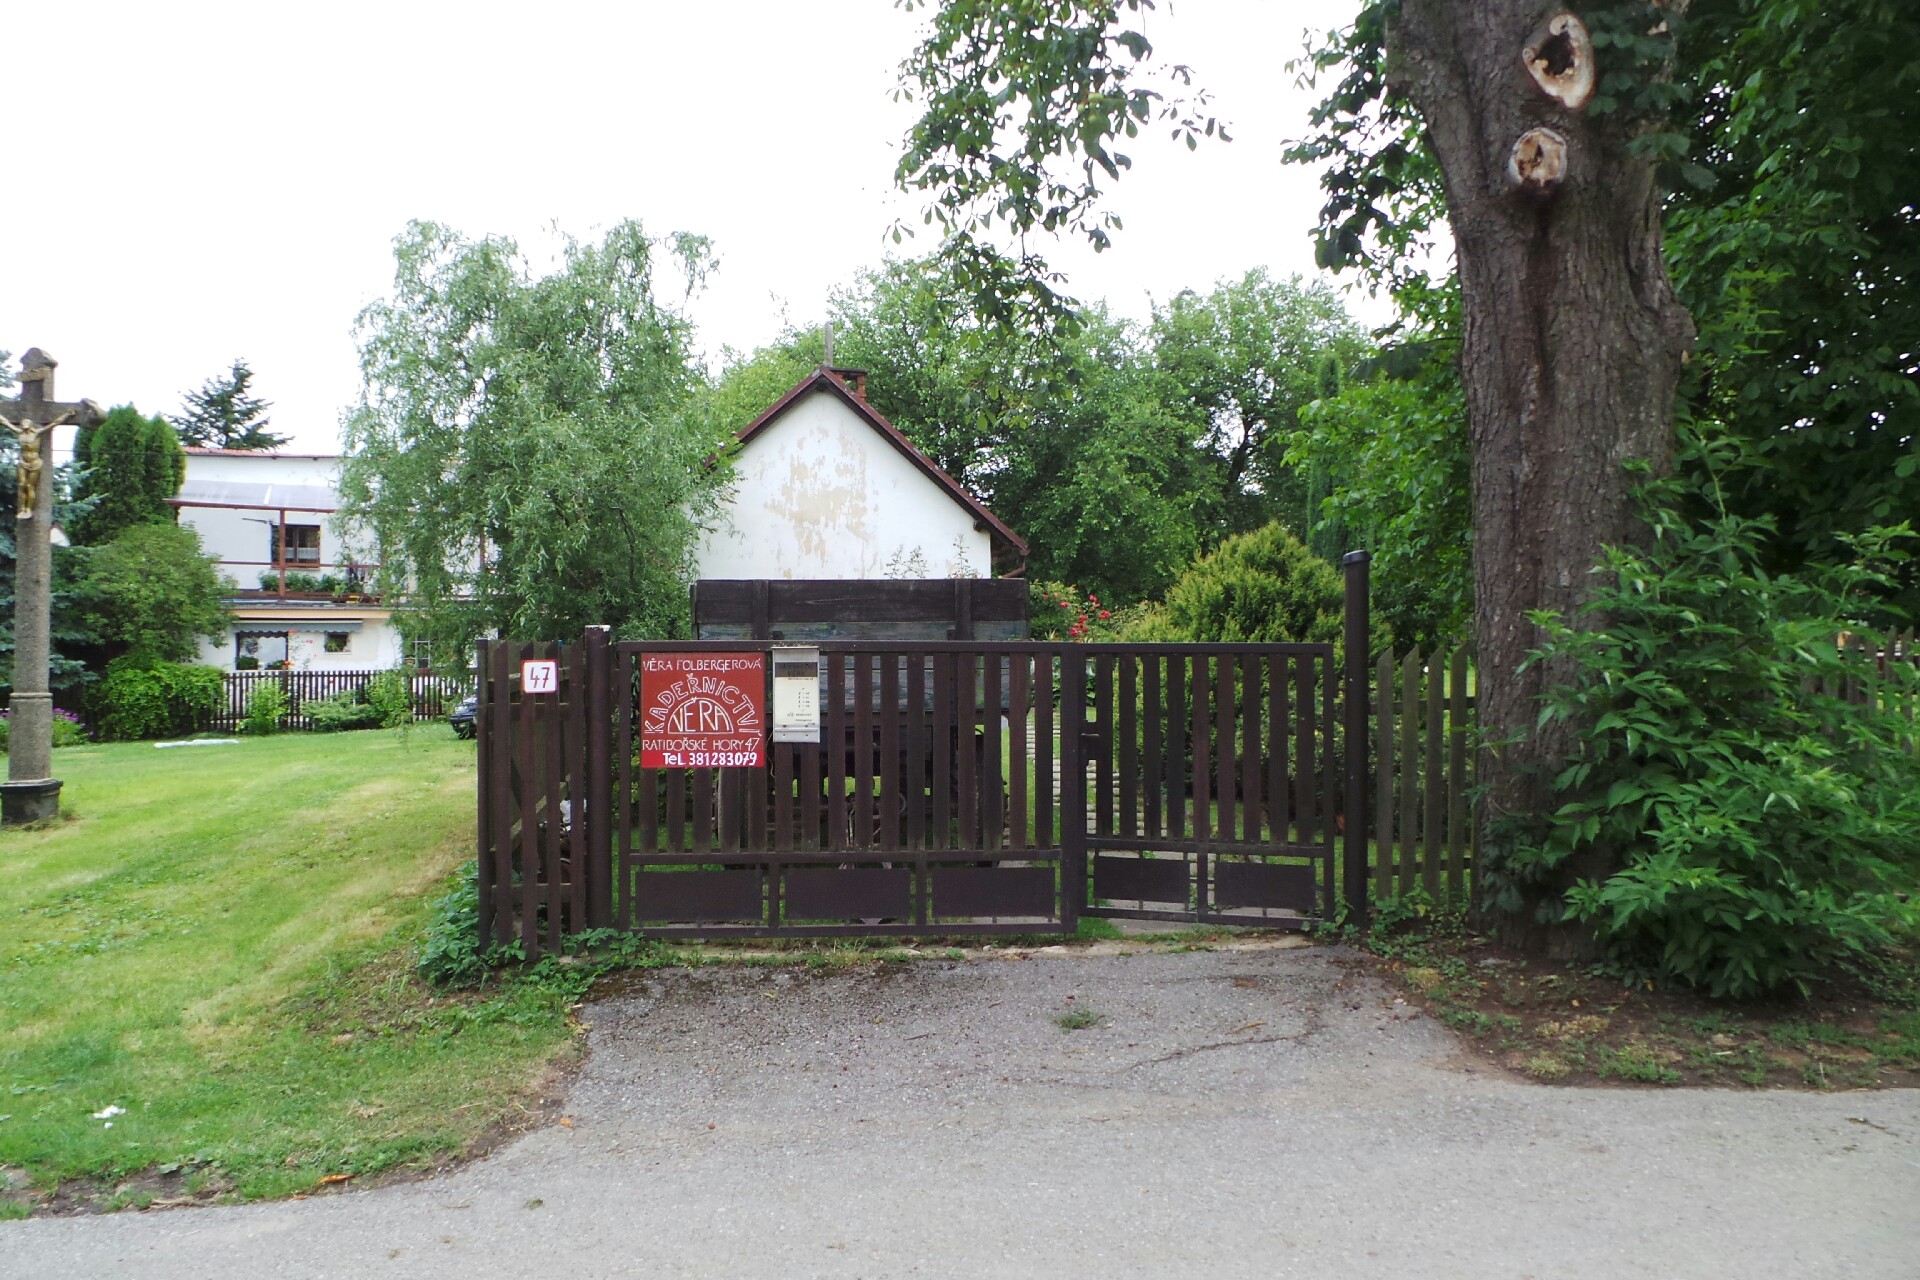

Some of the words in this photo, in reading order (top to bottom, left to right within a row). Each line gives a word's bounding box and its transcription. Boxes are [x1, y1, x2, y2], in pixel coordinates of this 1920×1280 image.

[643, 658, 673, 671] VĚRA
[676, 658, 761, 673] FOLBERGEROVÁ
[530, 667, 550, 688] 47
[644, 672, 762, 736] KADEŘNICTVÍ
[642, 737, 708, 751] RATIBOŘSKÉ
[713, 739, 744, 751] HORY
[744, 737, 760, 752] 47
[688, 752, 757, 766] 381283079
